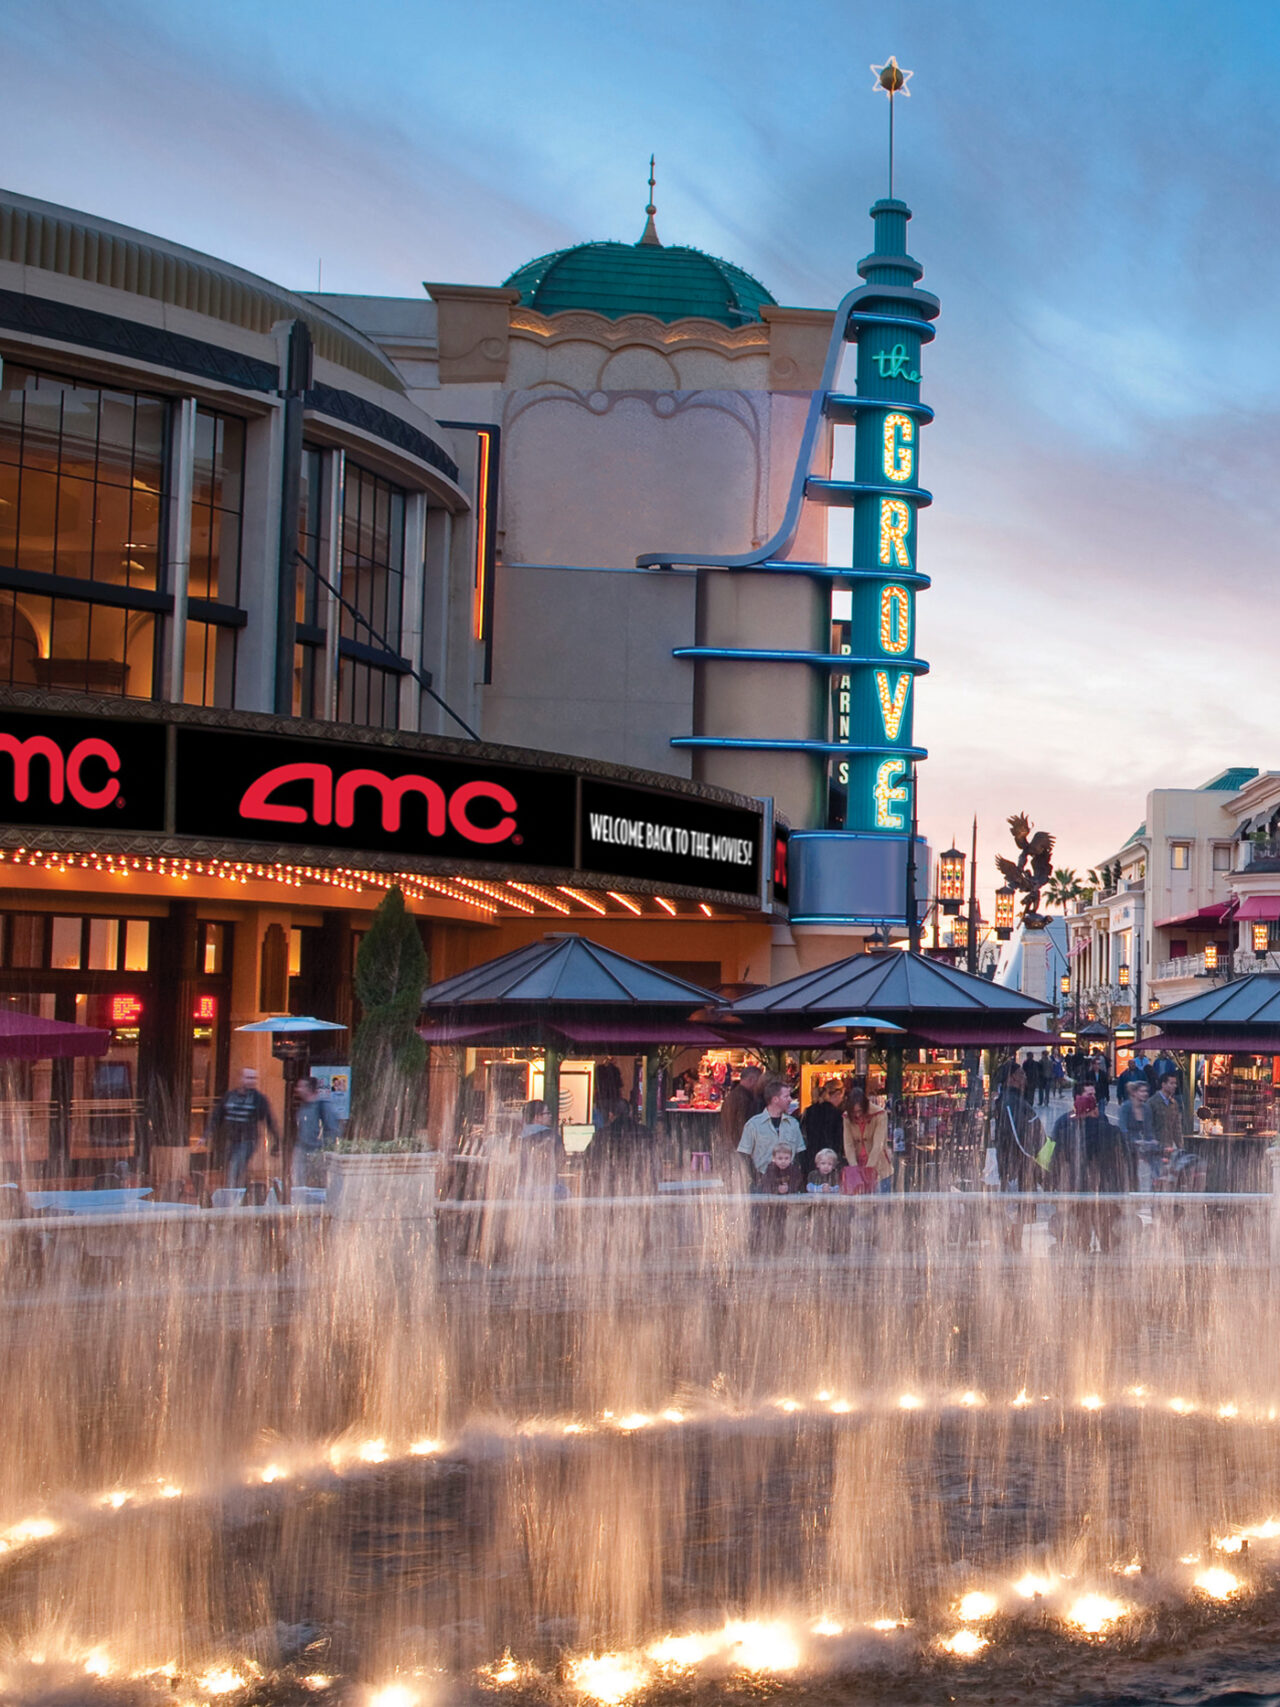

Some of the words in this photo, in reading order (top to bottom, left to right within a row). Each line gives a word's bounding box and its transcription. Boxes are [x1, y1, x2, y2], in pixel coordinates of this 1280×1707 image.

[872, 343, 922, 384] the
[873, 411, 915, 829] GROVE
[838, 643, 852, 785] BARNS
[0, 732, 123, 811] mc
[239, 762, 520, 844] amc
[589, 812, 645, 850] WELCOME
[646, 823, 674, 854] BACK
[675, 828, 690, 856] TO
[690, 830, 711, 860] THE
[712, 835, 753, 867] MOVIES!
